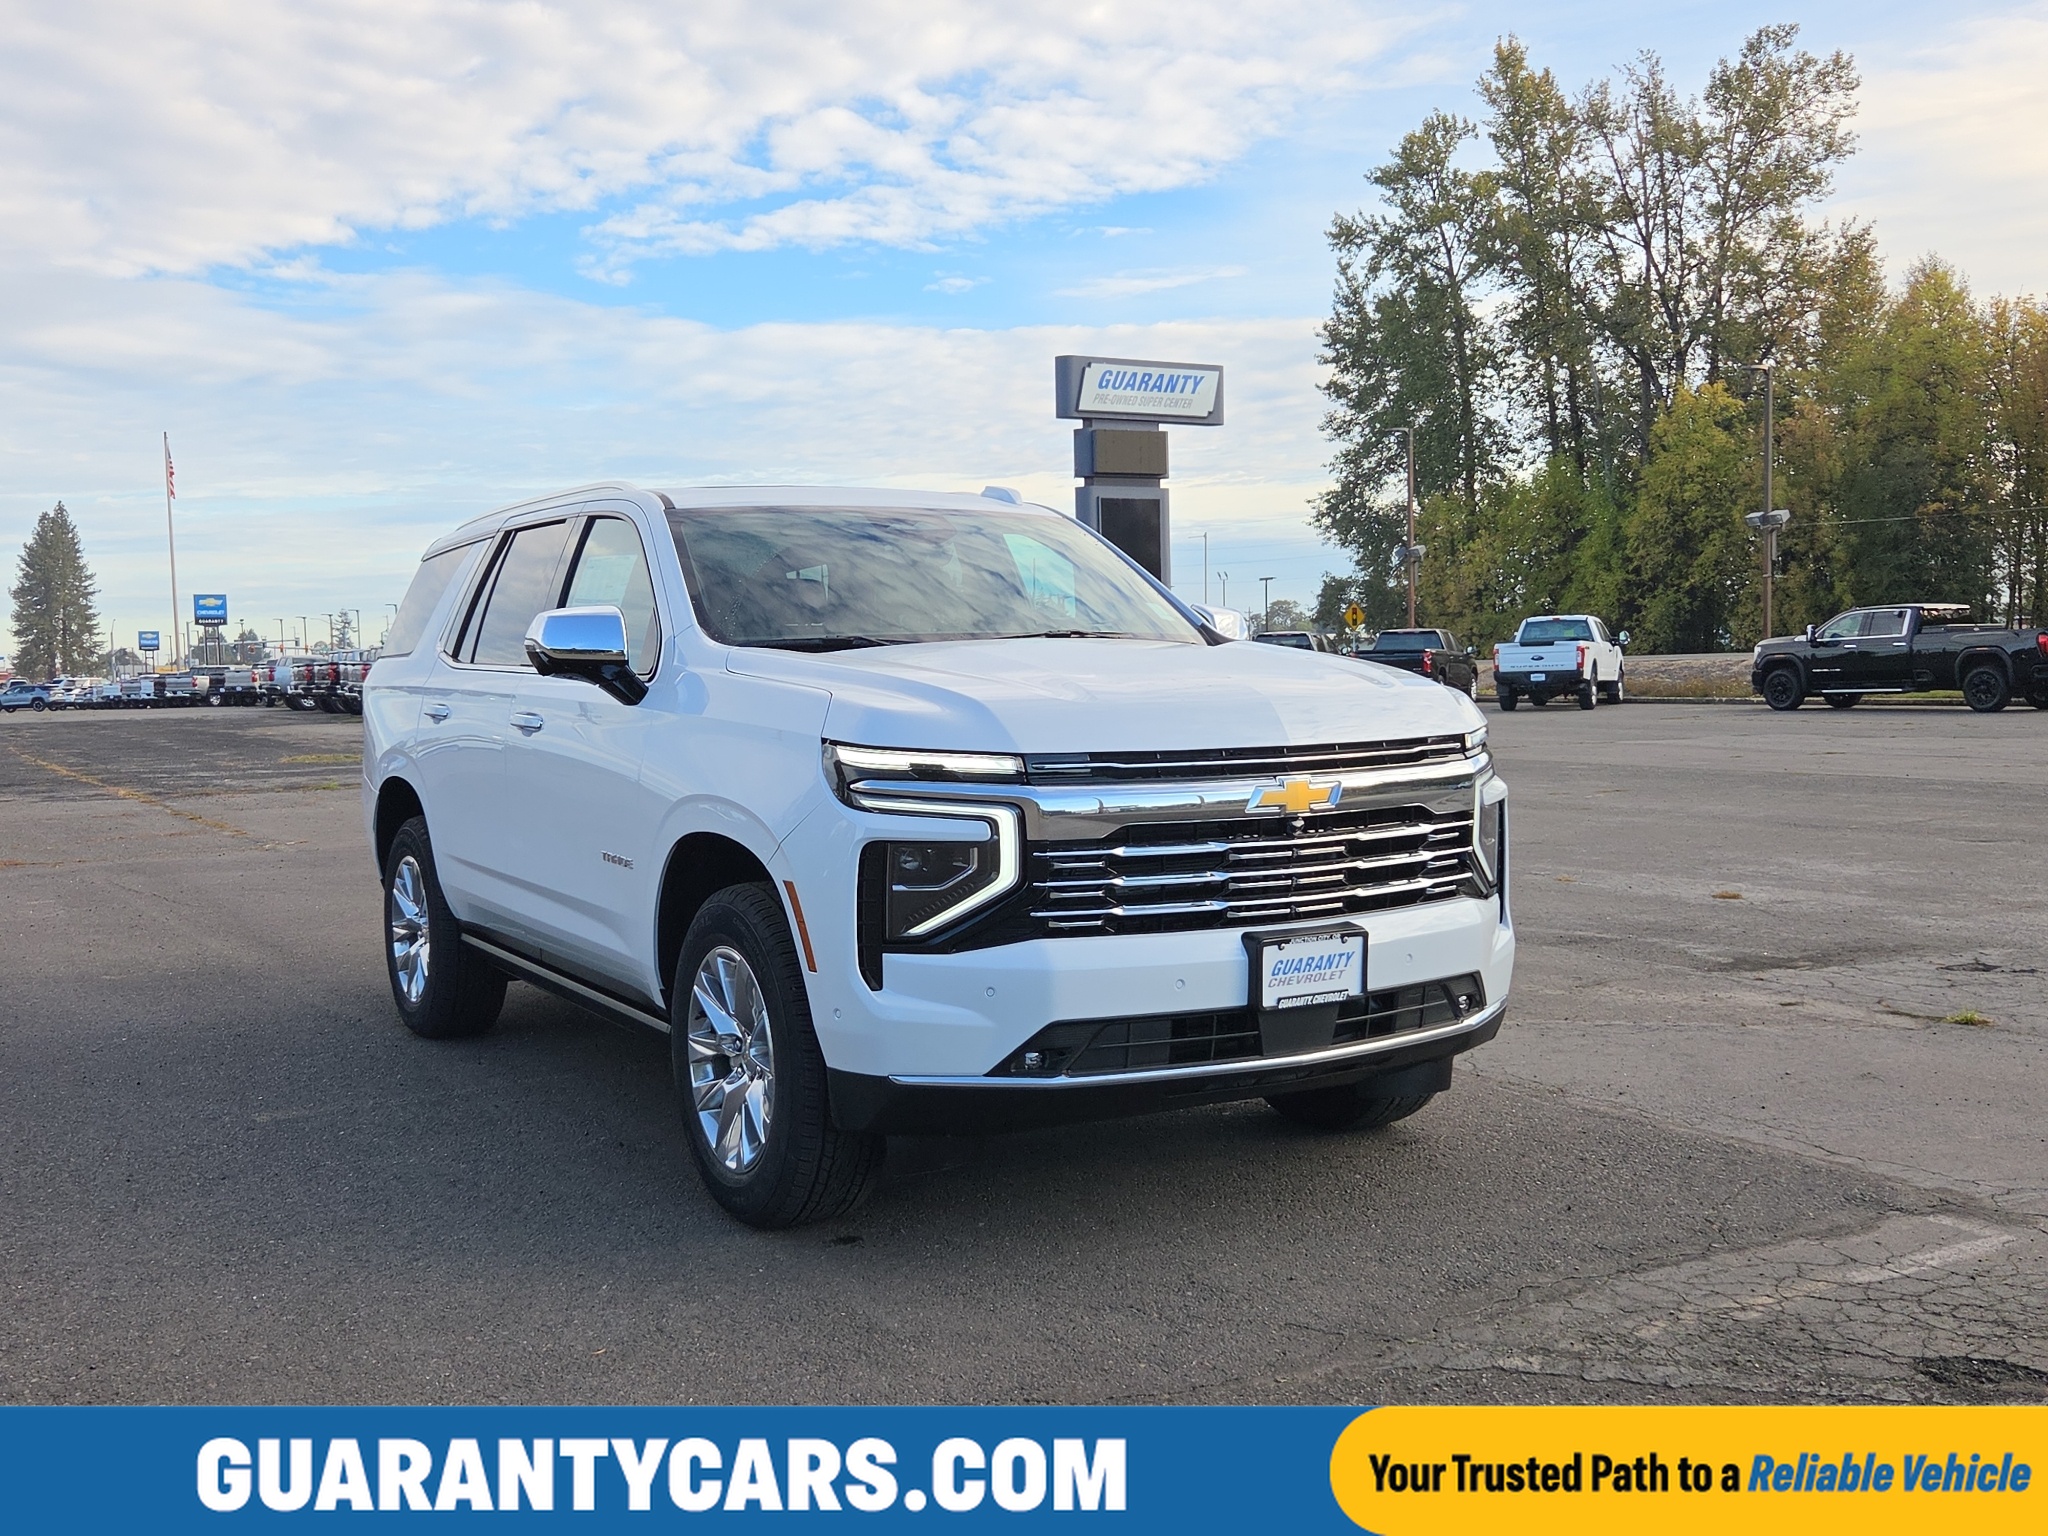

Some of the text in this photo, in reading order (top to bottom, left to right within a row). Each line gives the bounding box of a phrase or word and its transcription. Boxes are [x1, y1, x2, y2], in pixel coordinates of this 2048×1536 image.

[1097, 369, 1205, 395] GUARANTY
[1092, 392, 1194, 409] PRE-OWNED SUPER CENTER
[1271, 951, 1355, 977] GUARANTY
[1268, 969, 1346, 988] CHEVROLET
[1312, 991, 1349, 1005] CHEVROLET
